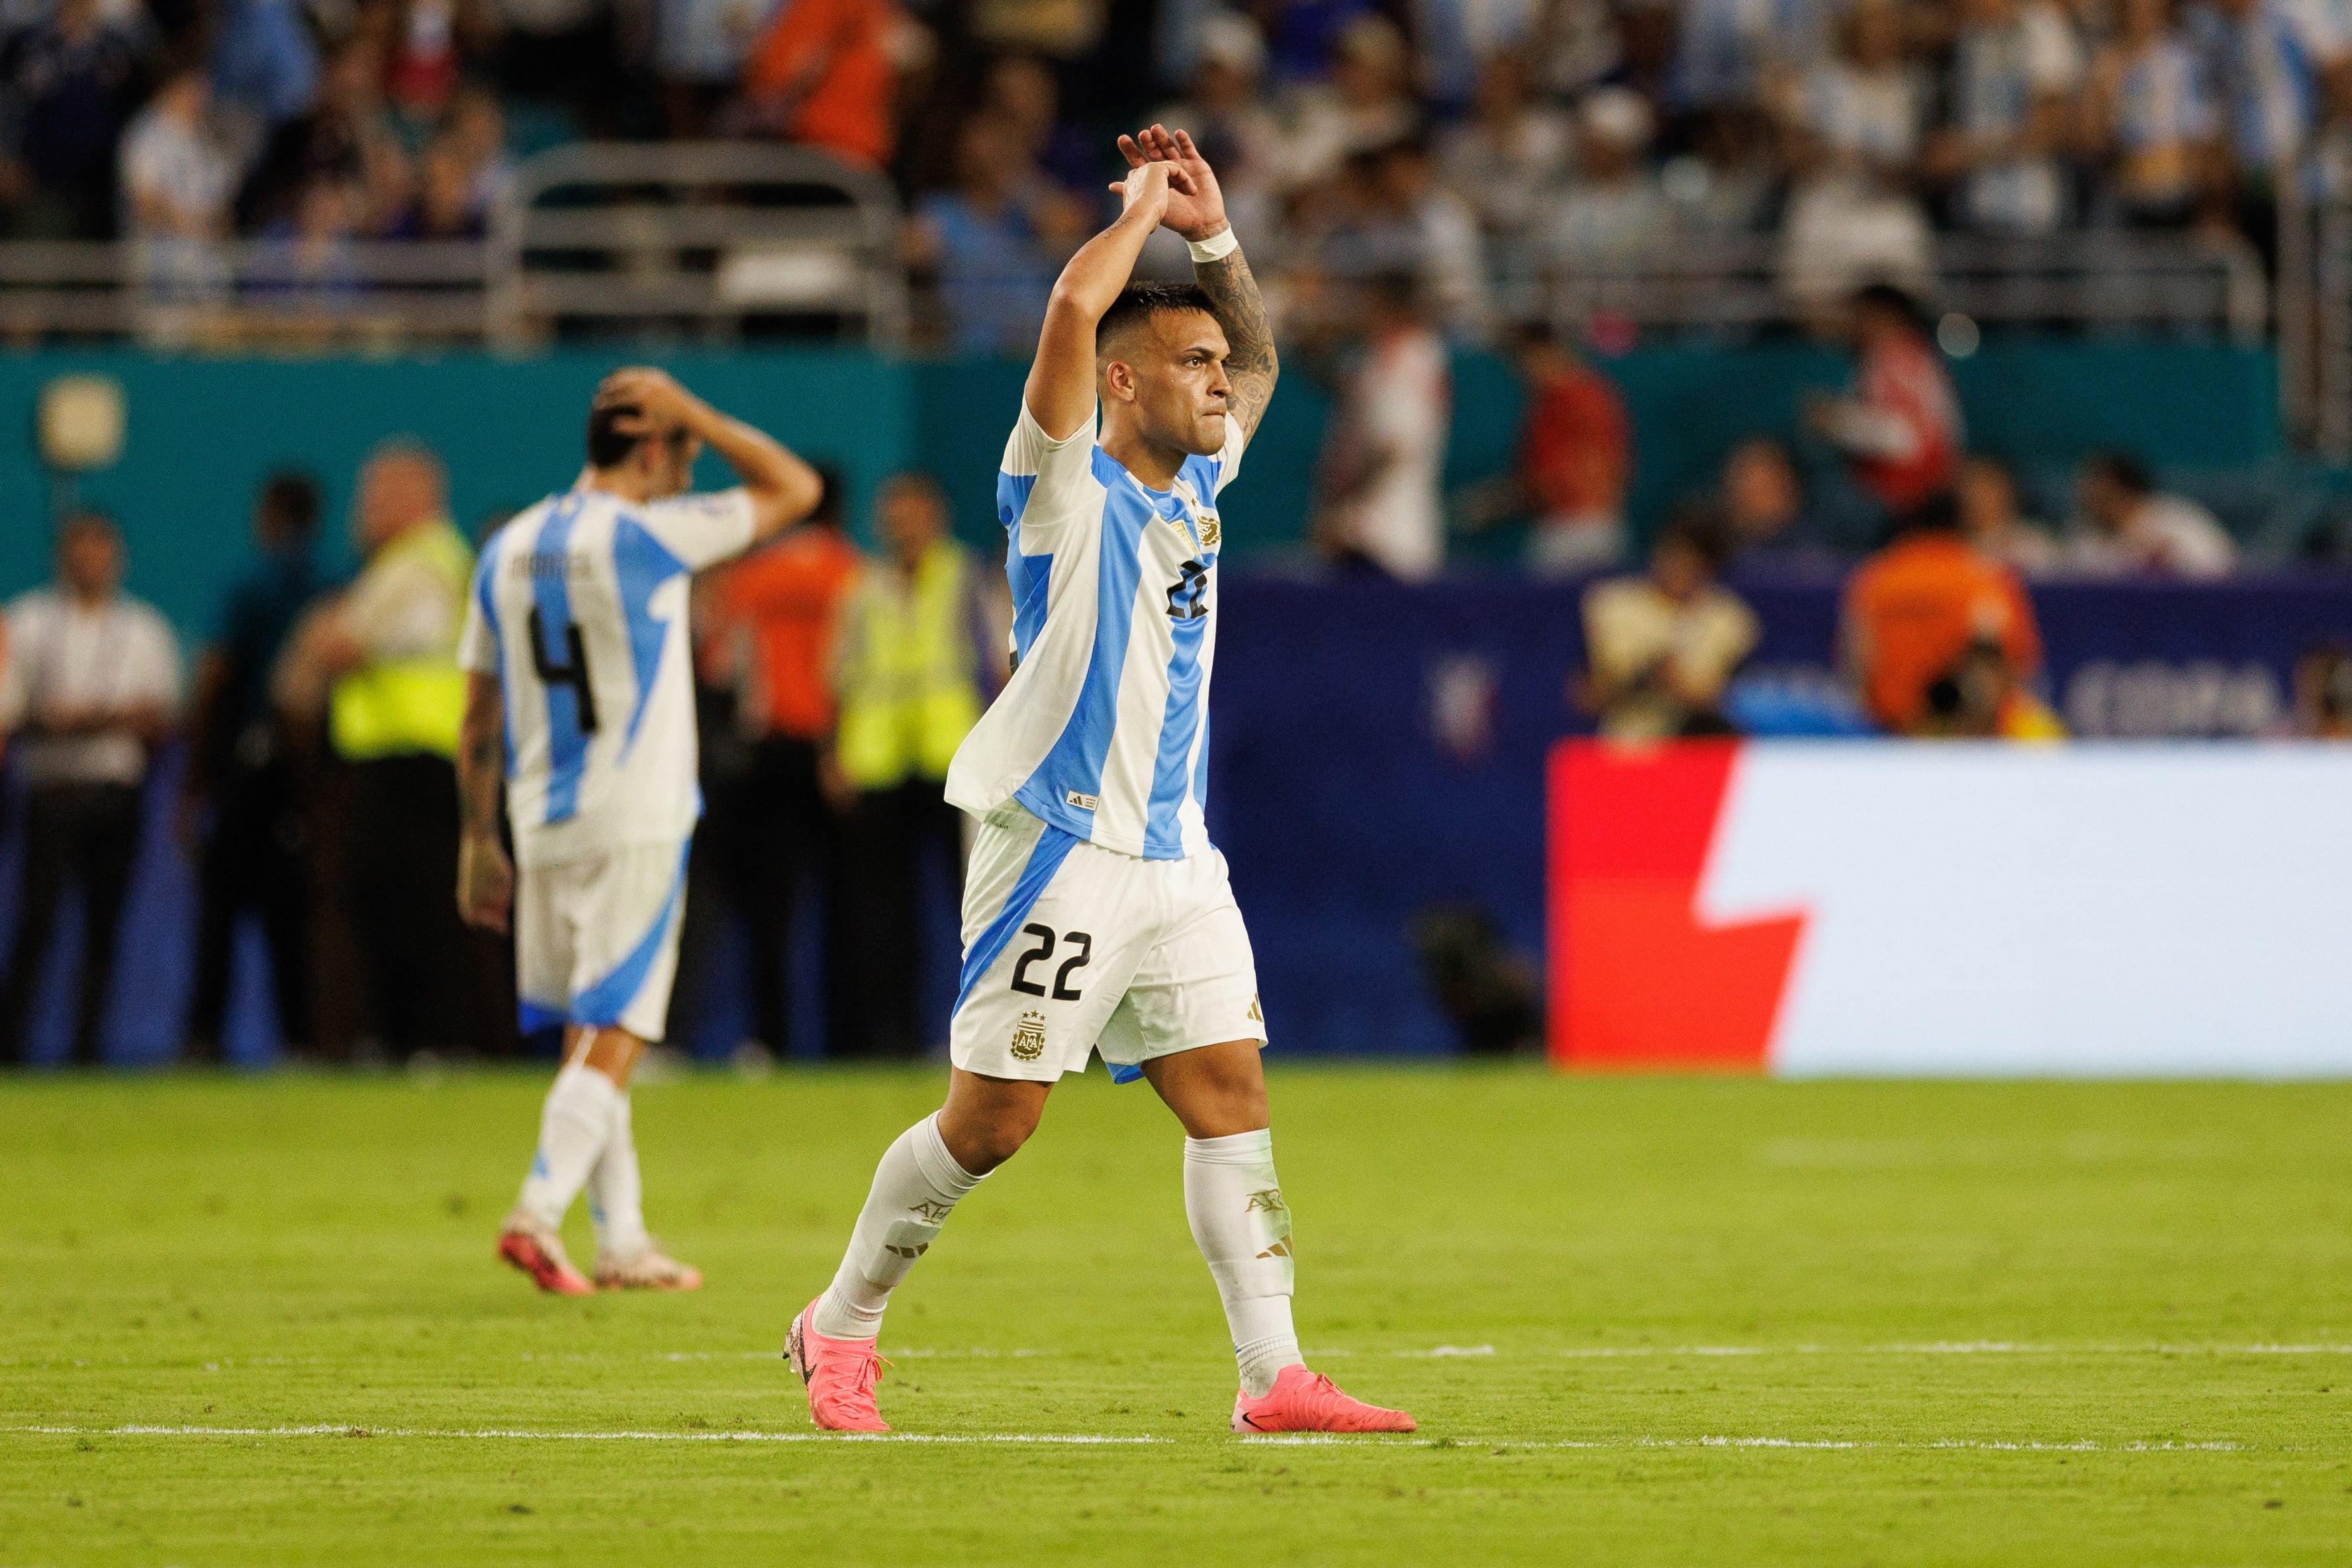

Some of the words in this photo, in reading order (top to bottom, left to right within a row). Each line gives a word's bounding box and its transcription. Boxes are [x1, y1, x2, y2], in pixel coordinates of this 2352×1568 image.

[1166, 560, 1209, 619] 22
[528, 607, 598, 735] 4
[1011, 923, 1092, 1001] 22
[1018, 1031, 1038, 1050] AFA
